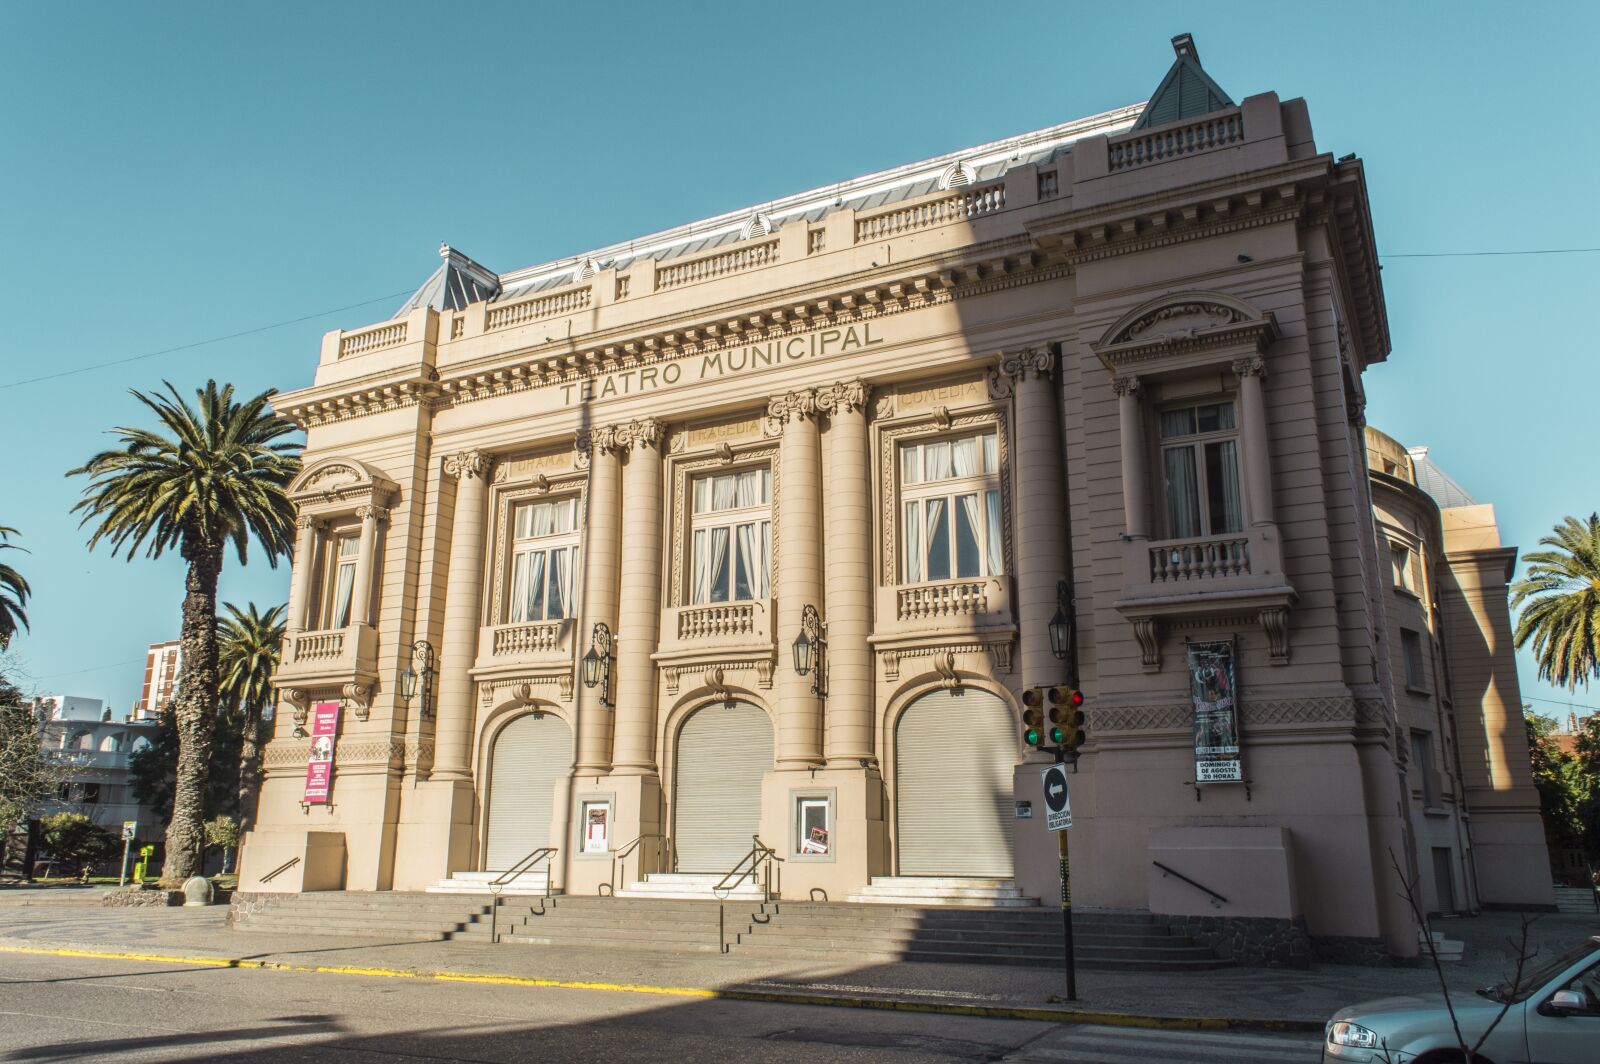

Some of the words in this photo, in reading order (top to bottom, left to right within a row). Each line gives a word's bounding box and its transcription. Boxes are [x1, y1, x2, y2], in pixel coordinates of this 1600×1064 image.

[560, 362, 681, 406] TEATRO
[699, 322, 884, 378] MUNICIPAL
[901, 383, 978, 406] COMEDIA
[691, 420, 759, 442] TRAGEDIA
[517, 455, 564, 472] DRAMA
